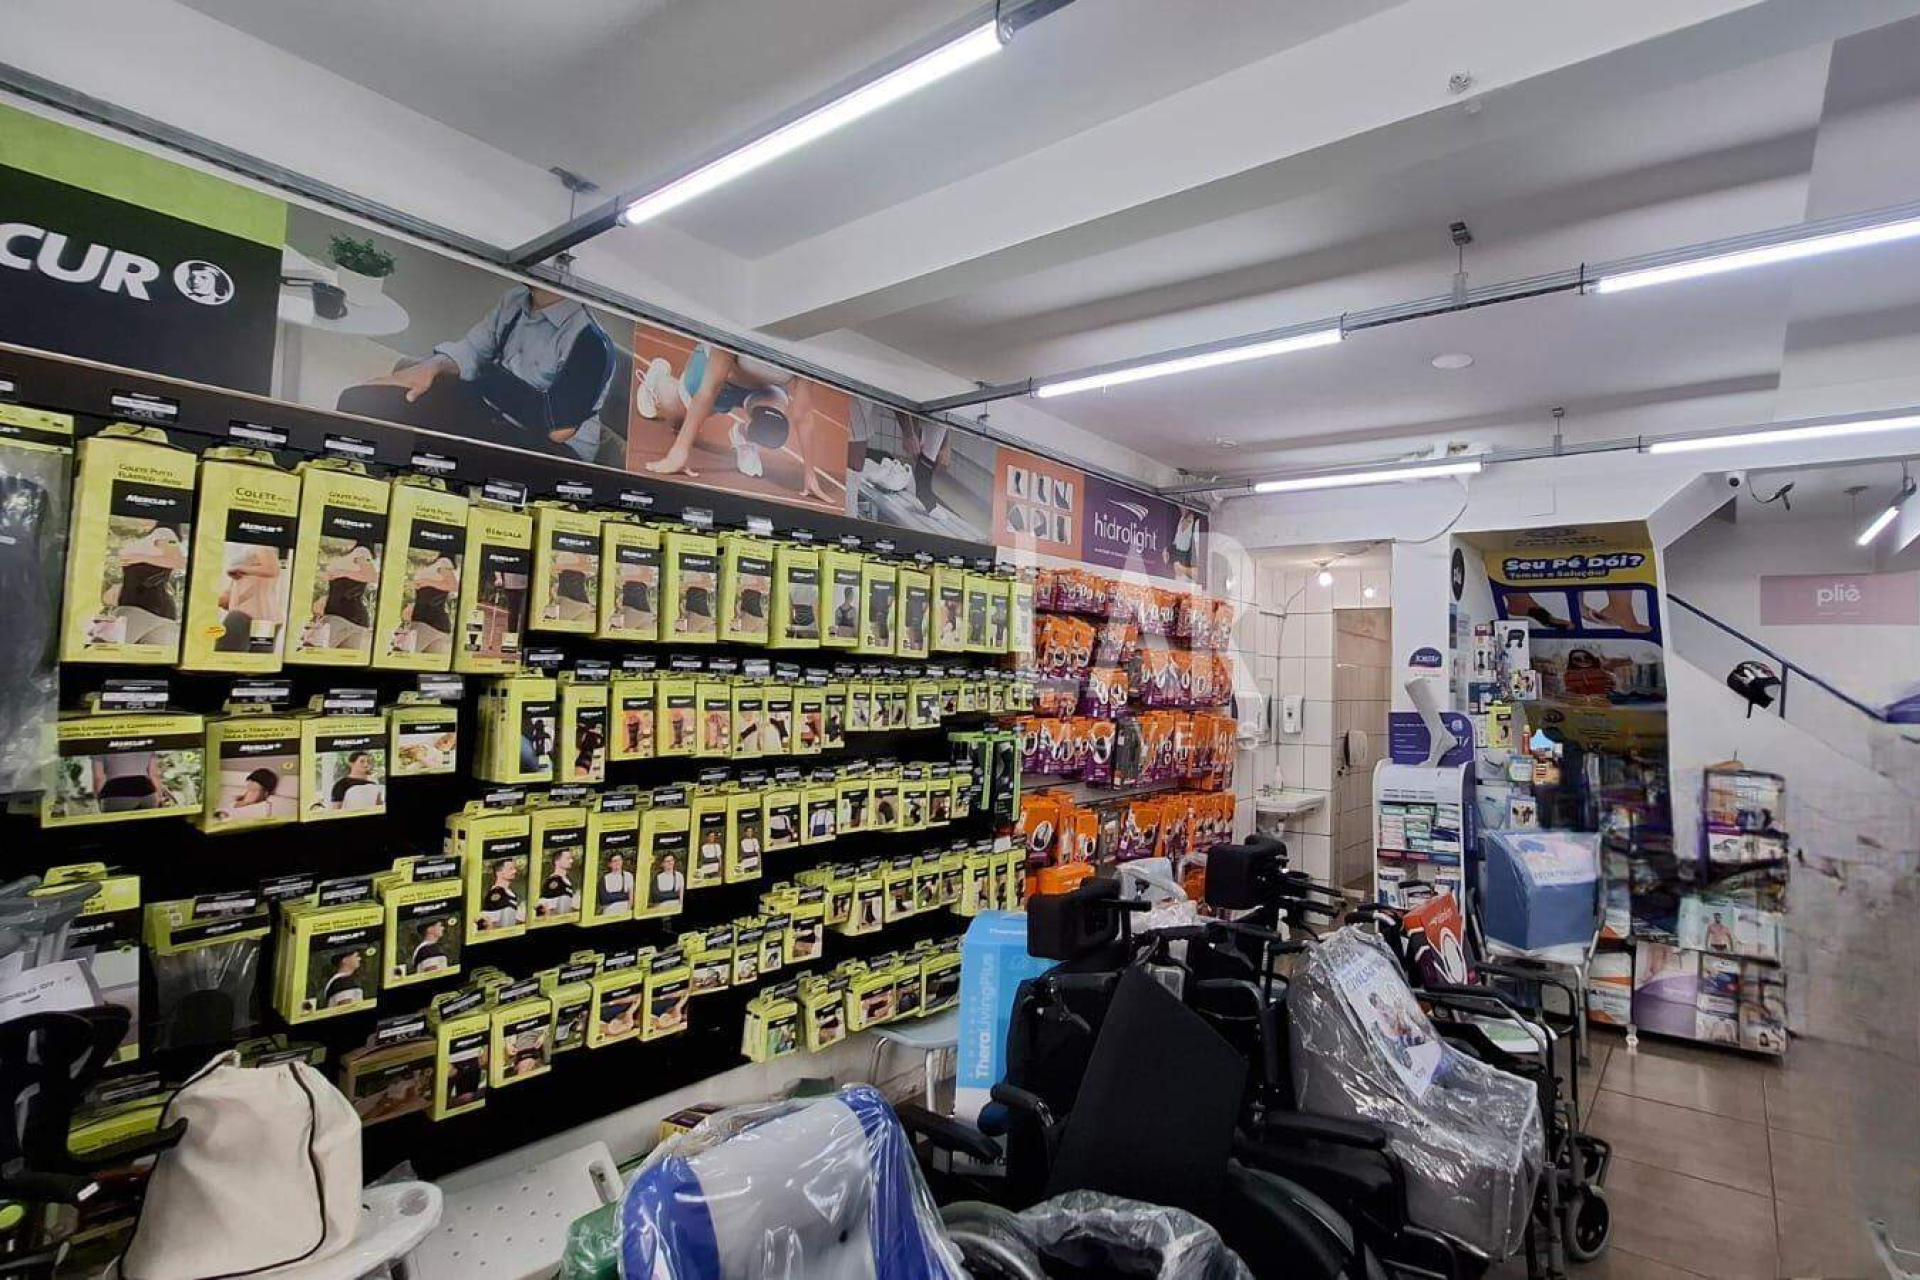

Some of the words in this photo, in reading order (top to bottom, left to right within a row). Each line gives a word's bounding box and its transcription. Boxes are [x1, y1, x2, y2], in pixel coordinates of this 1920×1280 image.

[1094, 511, 1157, 553] hidrolight
[1506, 559, 1546, 571] Seu
[1552, 556, 1580, 569] Pé
[1587, 555, 1644, 568] Dói?
